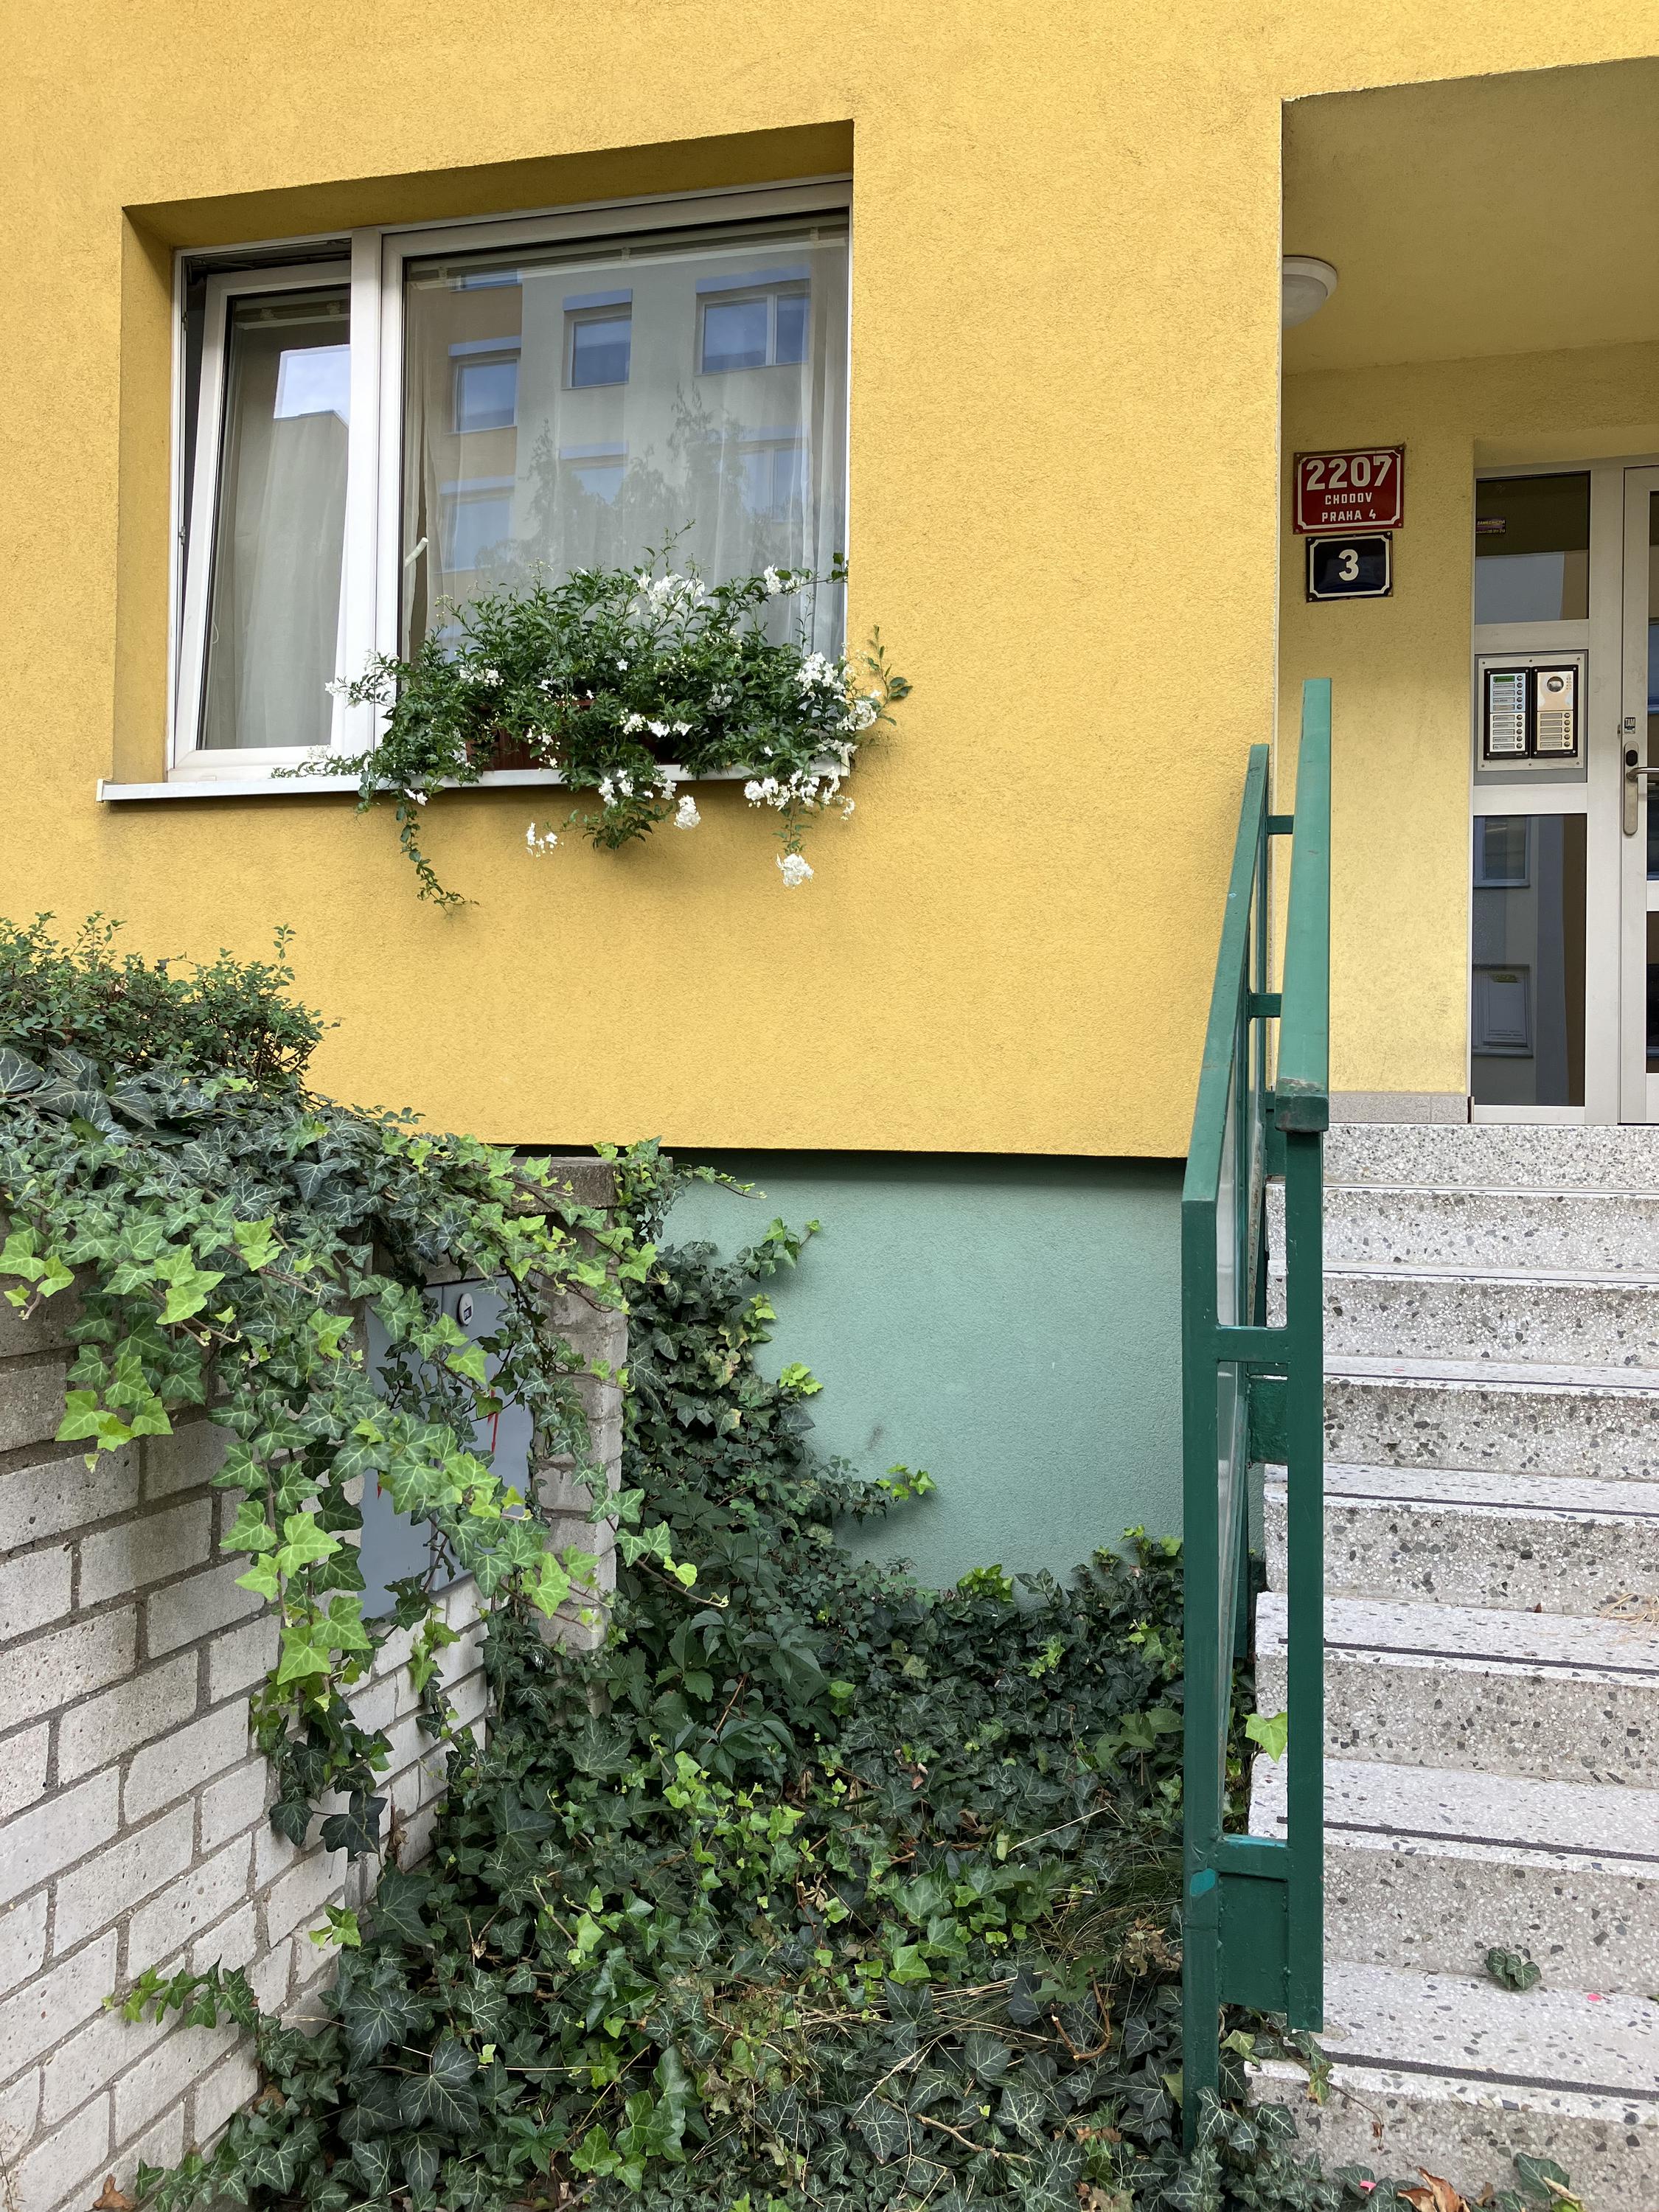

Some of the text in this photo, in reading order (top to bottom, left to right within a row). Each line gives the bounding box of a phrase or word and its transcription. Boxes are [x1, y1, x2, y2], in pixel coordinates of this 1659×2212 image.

[1307, 455, 1392, 491] 2207
[1325, 492, 1372, 505] CHODOV
[1322, 509, 1377, 522] PRAHA 4
[1338, 549, 1359, 581] 3
